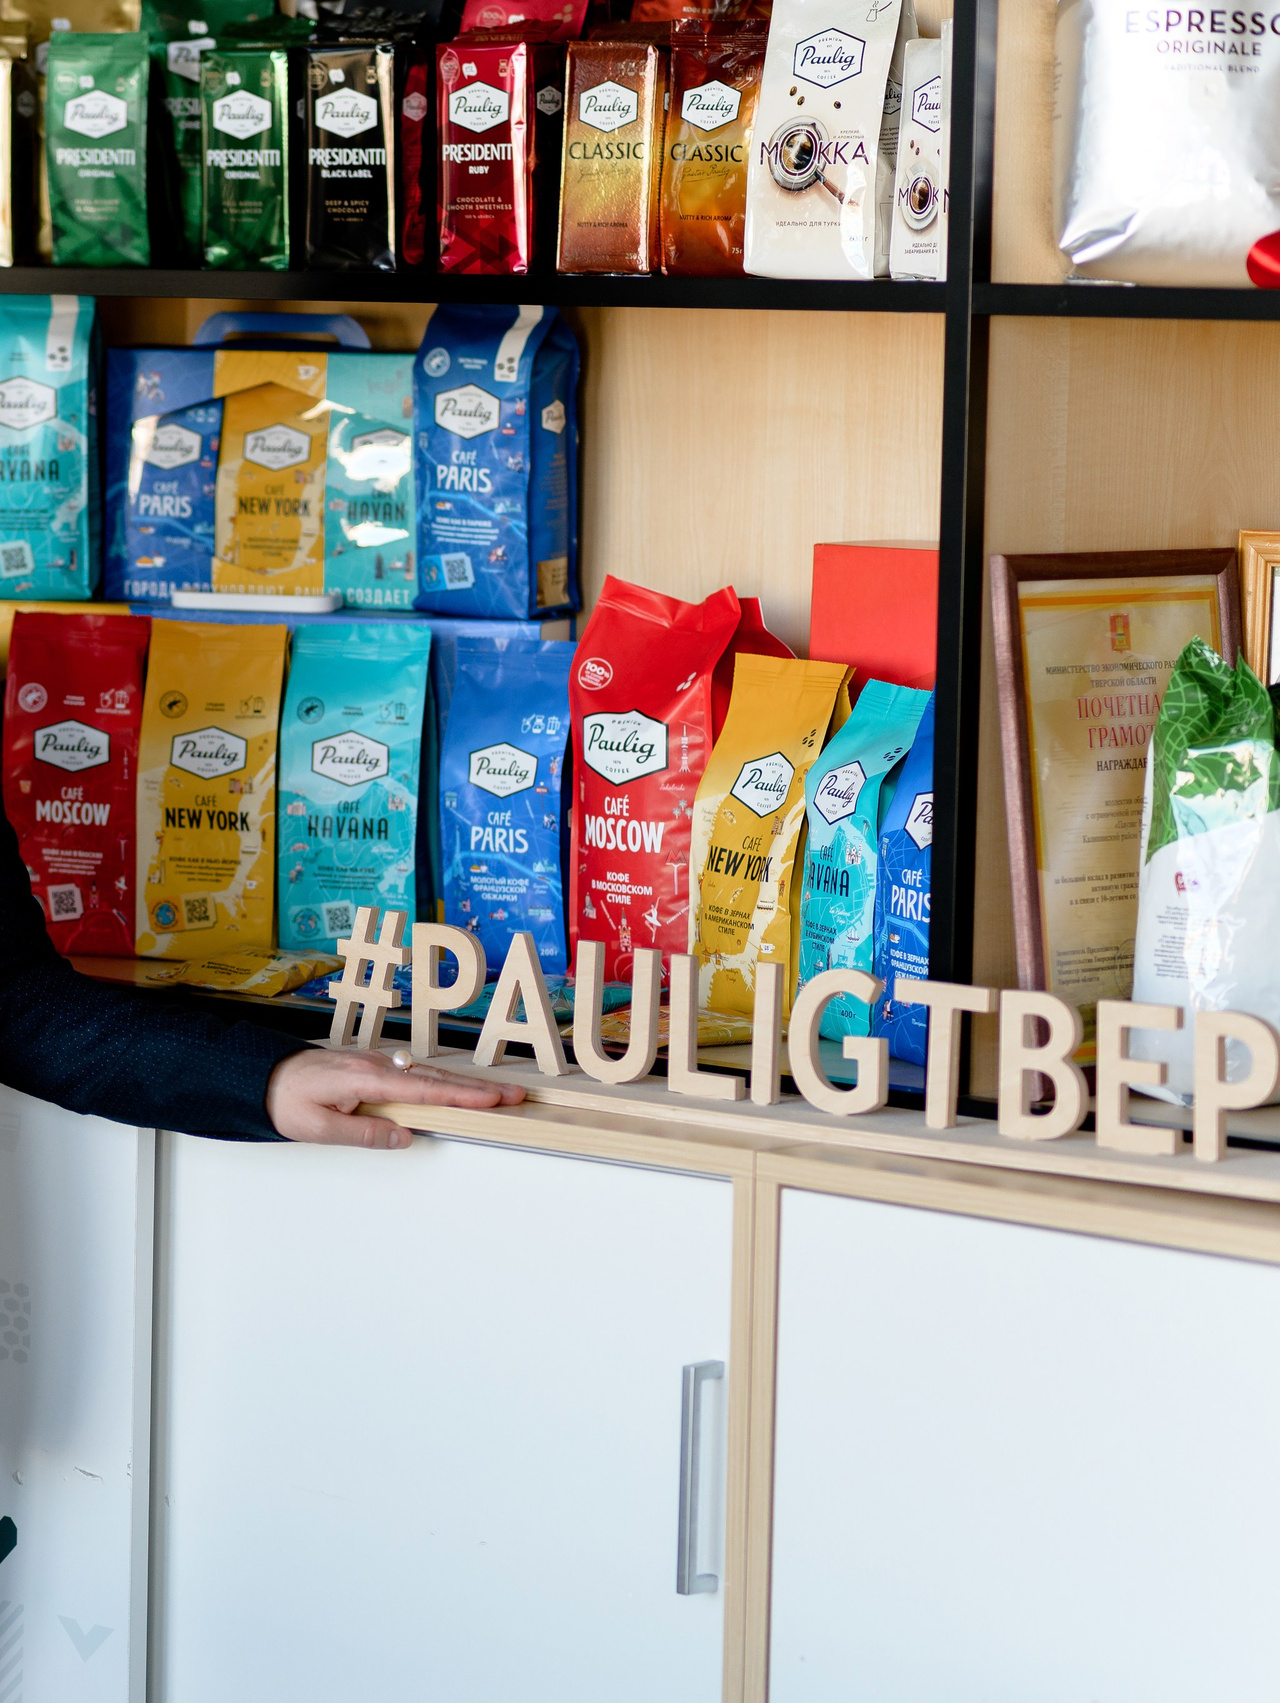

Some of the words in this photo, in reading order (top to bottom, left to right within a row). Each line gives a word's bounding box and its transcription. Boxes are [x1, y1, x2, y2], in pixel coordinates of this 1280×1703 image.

[1156, 40, 1262, 56] ORIGINALE
[800, 45, 856, 72] Paulig
[1228, 64, 1260, 74] BLEND
[218, 104, 266, 127] Paulig
[321, 101, 372, 125] Paulig
[454, 95, 503, 119] Paulig
[584, 95, 632, 119] Paulig
[686, 93, 734, 118] Paulig
[55, 148, 136, 167] PRESIDENTTI
[206, 149, 281, 169] PRESIDENTTI
[308, 148, 386, 168] PRESIDENTTI
[569, 142, 645, 160] CLASSIC
[670, 143, 743, 163] CLASSIC
[760, 128, 870, 176] MOKKA
[321, 169, 347, 178] BLACK
[348, 169, 373, 178] LABEL
[468, 165, 490, 175] RUBY
[440, 397, 493, 425] Paulig
[451, 450, 478, 466] CAFÉ
[436, 464, 493, 493] PARIS
[138, 494, 193, 519] PARIS
[238, 496, 270, 516] NEW
[274, 498, 311, 517] YORK
[124, 579, 176, 598] ГОРОДА
[346, 588, 410, 605] СОЗДАЕТ
[1045, 664, 1101, 675] МИНИСТЕРСТВО
[1101, 660, 1163, 672] ЭКОНОМИЧЕСКОГО
[1090, 677, 1125, 688] ТВЕРСКОЙ
[1125, 676, 1157, 686] ОБЛАСТИ
[1077, 692, 1161, 720] ПОЧЕТНА
[588, 723, 657, 764] Paulig
[1087, 723, 1155, 749] ГРАМОТ
[42, 733, 103, 760] Paulig
[178, 740, 241, 767] Paulig
[319, 745, 382, 772] Paulig
[1096, 757, 1148, 771] НАГРАЖДАЕ
[476, 756, 530, 784] Paulig
[61, 785, 84, 801] CAFÉ
[742, 768, 787, 801] Paulig
[820, 774, 855, 808] Paulig
[194, 793, 217, 808] CAFÉ
[337, 798, 361, 814] CAFÉ
[604, 794, 630, 817] CAFÉ
[35, 799, 111, 826] MOSCOW
[164, 807, 203, 829] NEW
[206, 809, 251, 832] YORK
[487, 809, 512, 827] CAFÉ
[308, 814, 389, 841] HAVANA
[584, 813, 665, 854] MOSCOW
[470, 826, 529, 854] PARIS
[742, 834, 764, 852] CAFÉ
[707, 845, 746, 877] NEW
[744, 854, 773, 883] YORK
[820, 844, 834, 864] CAFÉ
[470, 876, 506, 886] МОЛОТЫЙ
[507, 878, 530, 887] КОФЕ
[606, 871, 630, 883] КОФЕ
[809, 861, 850, 898] AVANA
[901, 868, 923, 888] CAFÉ
[472, 884, 527, 895] ФРАНЦУЗСКОЙ
[481, 892, 518, 902] ОБЖАРКИ
[596, 880, 653, 896] МОСКОВСКОМ
[606, 893, 632, 905] СТИЛЕ
[708, 903, 723, 915] КОФЕ
[729, 909, 752, 920] ЗЕРНАХ
[708, 913, 755, 931] АМЕРИКАНСКОМ
[717, 925, 736, 936] СТИЛЕ
[890, 948, 905, 960] КОФЕ
[891, 957, 929, 975] ФРАНЦУЗСКОЙ
[840, 1010, 853, 1019] 400
